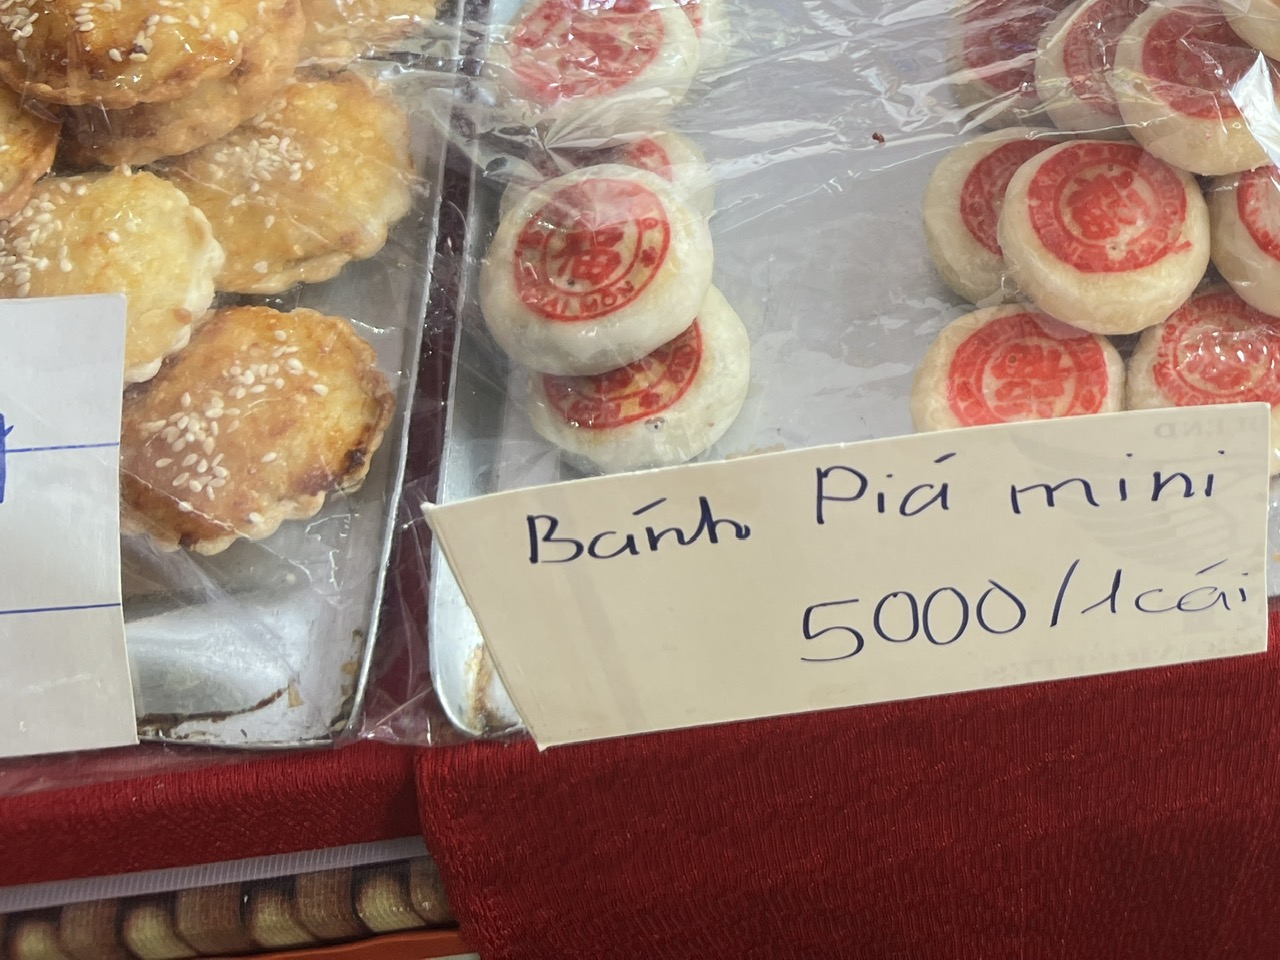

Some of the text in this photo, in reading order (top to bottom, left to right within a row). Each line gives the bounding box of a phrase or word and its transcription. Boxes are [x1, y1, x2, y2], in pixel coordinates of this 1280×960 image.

[527, 449, 1226, 565] Bánh Piá mini
